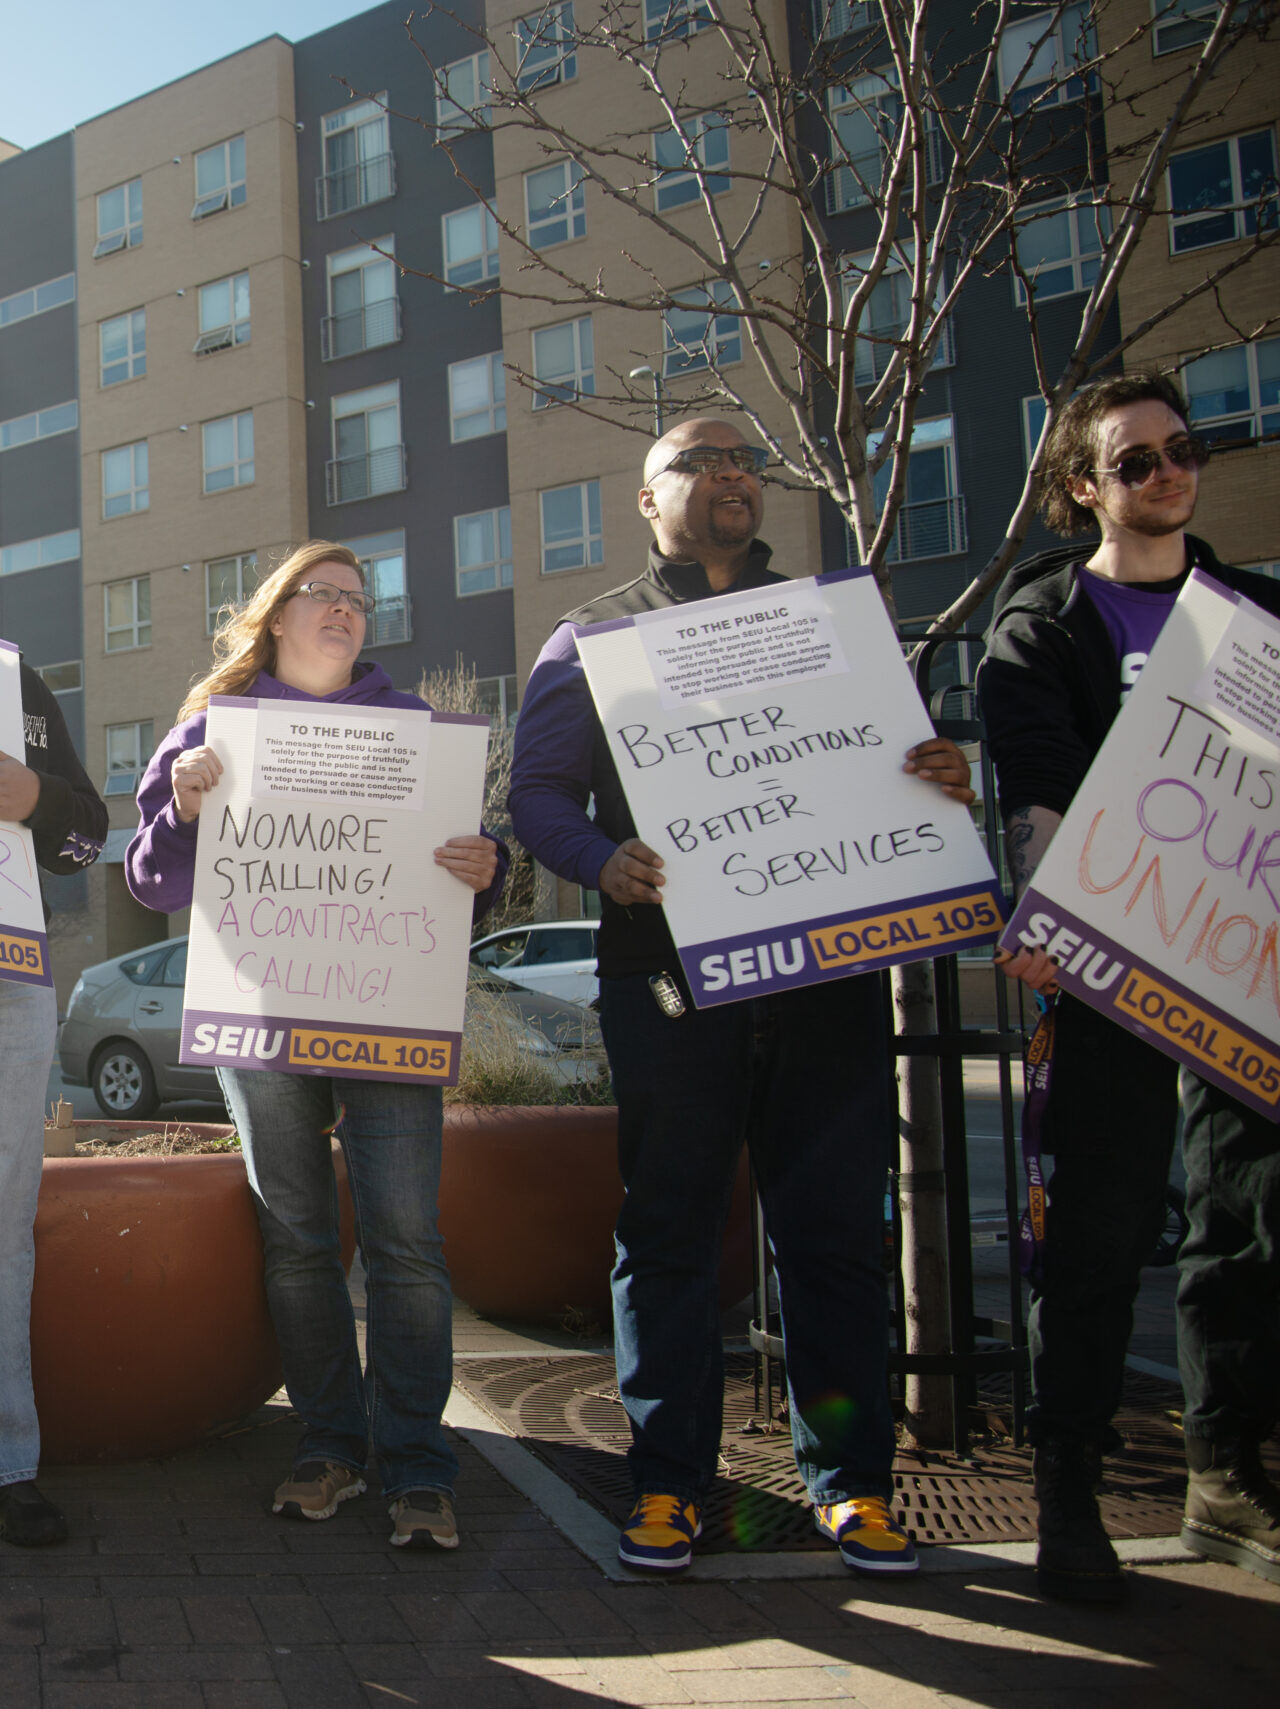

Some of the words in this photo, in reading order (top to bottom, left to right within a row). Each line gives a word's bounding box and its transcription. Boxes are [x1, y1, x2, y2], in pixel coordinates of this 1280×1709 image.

[656, 647, 676, 656] This
[677, 639, 717, 651] message
[718, 634, 740, 642] from
[741, 627, 763, 638] SEIU
[764, 622, 790, 633] Local
[791, 617, 808, 627] 105
[676, 627, 697, 639] TO
[699, 619, 731, 633] THE
[734, 607, 788, 626] PUBLIC
[1232, 641, 1249, 658] This
[1250, 656, 1280, 680] messa
[1232, 656, 1257, 676] solely
[1258, 671, 1271, 683] for
[1262, 641, 1280, 660] TO
[1213, 679, 1223, 688] to
[1224, 686, 1243, 701] stop
[1244, 700, 1278, 725] working
[1214, 667, 1251, 695] intended
[1253, 692, 1262, 702] to
[1235, 669, 1274, 699] informing
[1216, 692, 1236, 708] their
[1237, 705, 1274, 733] business
[265, 737, 283, 745] This
[284, 740, 322, 749] message
[323, 742, 343, 750] from
[344, 743, 365, 751] SEIU
[367, 745, 390, 753] Local
[392, 747, 407, 755] 105
[408, 748, 417, 756] is
[290, 724, 308, 735] TO
[312, 726, 339, 737] THE
[344, 728, 394, 741] PUBLIC
[617, 706, 796, 770] BETTER
[706, 724, 883, 778] CONDITIONS
[270, 747, 295, 756] solely
[326, 752, 359, 760] purpose
[371, 755, 410, 765] truthfully
[277, 757, 316, 767] informing
[333, 761, 359, 769] public
[1159, 696, 1278, 811] THIS
[260, 764, 297, 773] intended
[309, 769, 348, 777] persuade
[386, 775, 416, 783] anyone
[269, 783, 289, 791] their
[290, 785, 327, 794] business
[349, 789, 365, 797] this
[367, 792, 405, 801] employer
[274, 775, 292, 783] stop
[294, 777, 327, 786] working
[366, 783, 412, 793] conducting
[666, 794, 815, 853] BETTER
[722, 823, 945, 897] SERVICES
[1136, 778, 1280, 914] OUR
[213, 857, 392, 901] STALLING!
[217, 901, 240, 937] A
[250, 897, 436, 954] CONTRACT'S
[699, 936, 807, 992] SEIU
[815, 917, 931, 962] LOCAL
[935, 901, 997, 937] 105
[232, 951, 392, 1008] CALLING!
[1017, 910, 1125, 992] SEIU
[1121, 978, 1224, 1059] LOCAL
[1228, 1043, 1280, 1105] 105
[190, 1022, 285, 1059] SEIU
[293, 1036, 388, 1066] LOCAL
[394, 1044, 447, 1071] 105
[1034, 1062, 1049, 1090] SEIU
